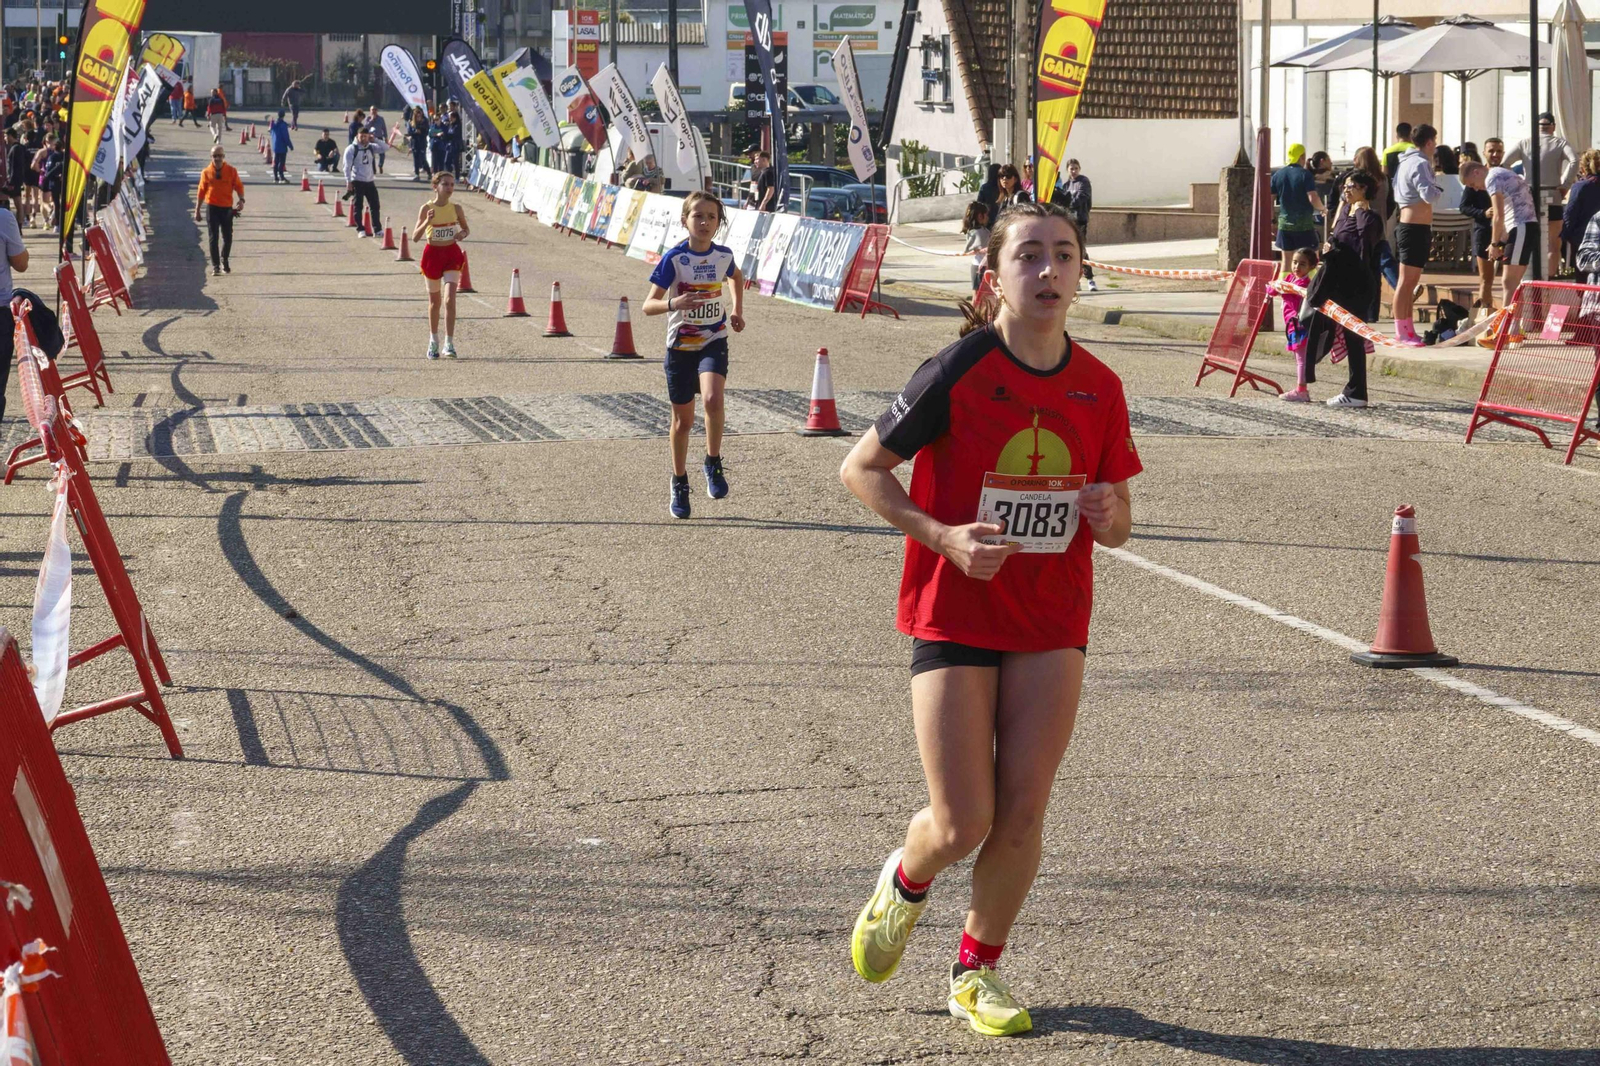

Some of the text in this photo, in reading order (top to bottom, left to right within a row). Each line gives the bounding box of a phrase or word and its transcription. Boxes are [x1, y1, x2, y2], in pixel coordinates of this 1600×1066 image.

[833, 11, 874, 19] MATEMÁTICAS
[577, 27, 597, 35] LASAL
[560, 77, 578, 93] Giga
[472, 80, 506, 122] ELECPOR
[611, 76, 634, 113] Maceira
[435, 227, 454, 238] 3075
[1020, 493, 1052, 501] CANDELA
[994, 500, 1069, 537] 3083
